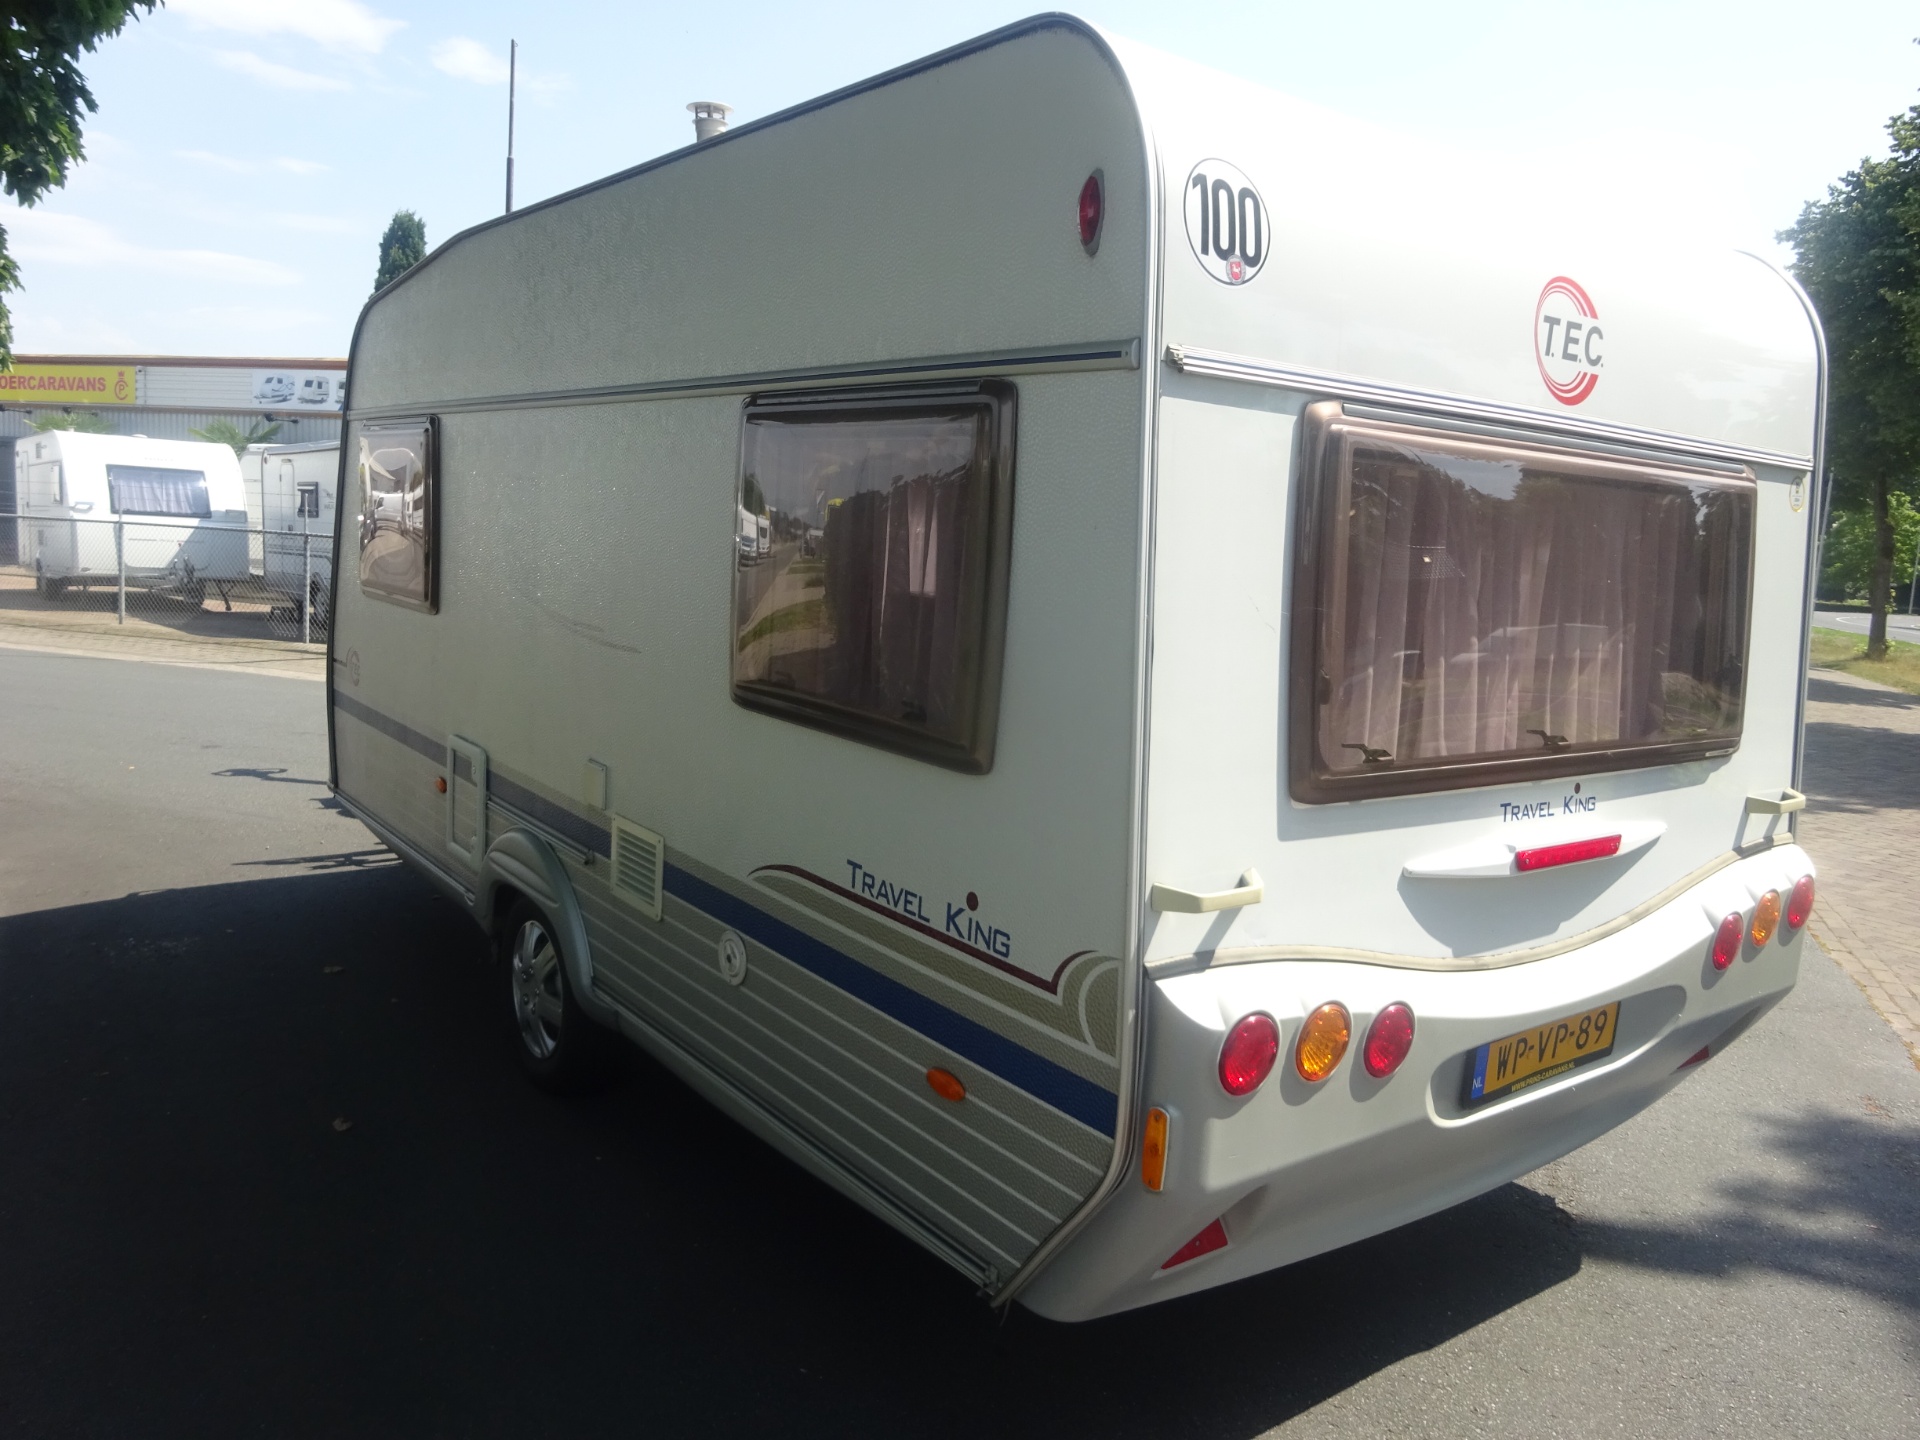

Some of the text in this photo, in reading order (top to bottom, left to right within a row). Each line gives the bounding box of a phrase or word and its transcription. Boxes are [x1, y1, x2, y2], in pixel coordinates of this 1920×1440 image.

[1191, 172, 1262, 268] 100
[0, 375, 106, 392] OERCARAVANS
[1500, 801, 1555, 823] TRAVEL
[846, 858, 930, 924] TRAVEL
[1496, 1009, 1608, 1081] WP-VP-89
[1472, 1076, 1483, 1090] NL
